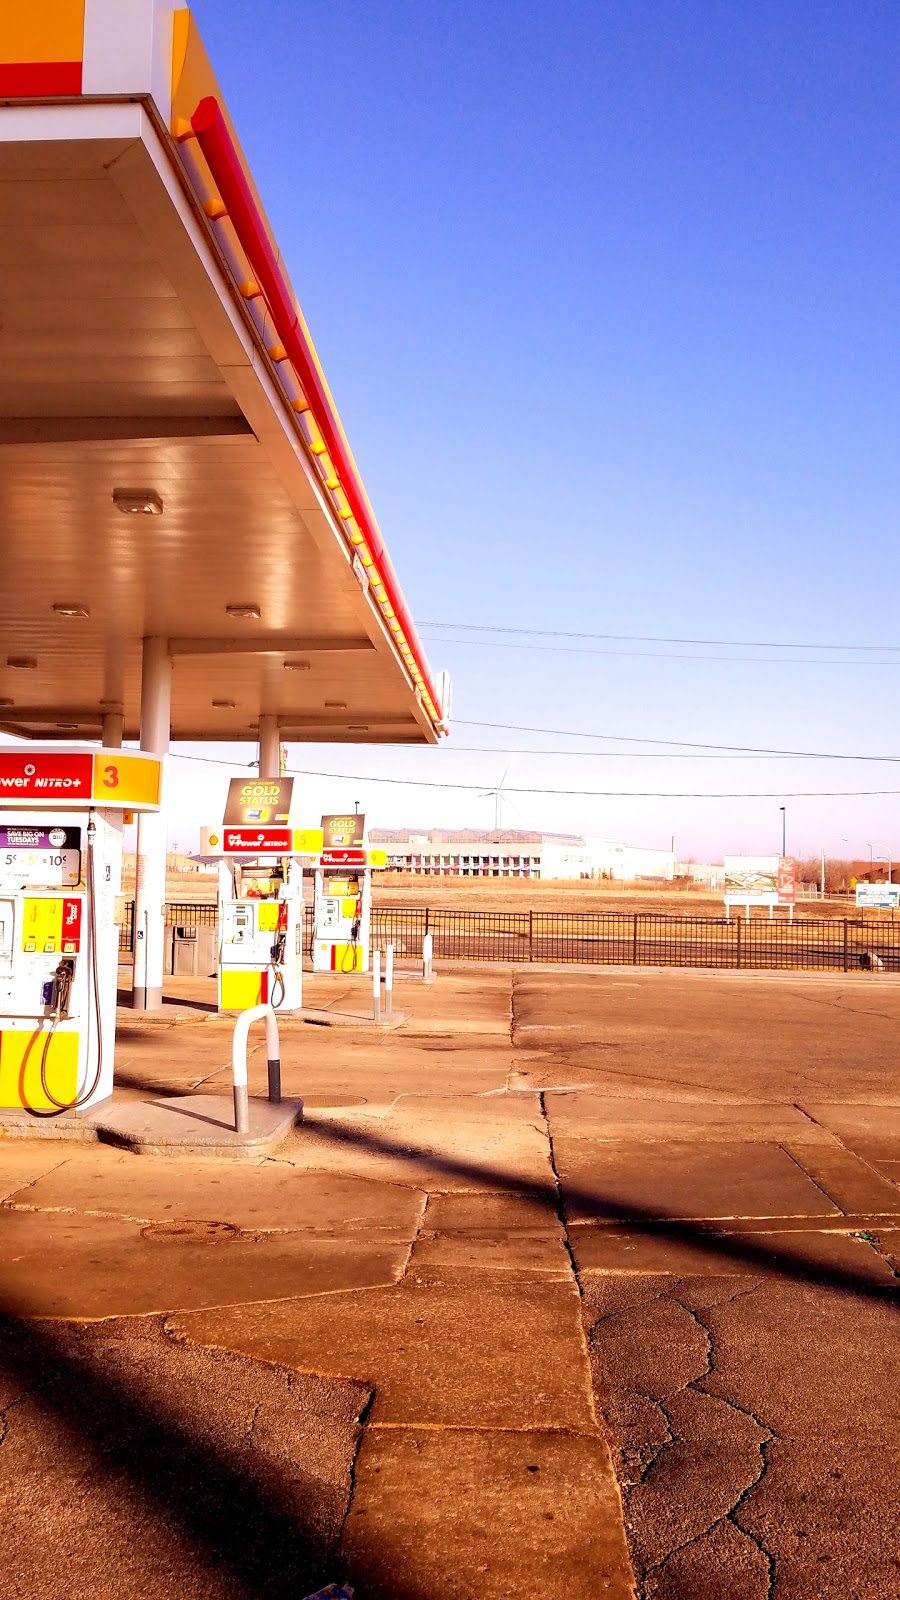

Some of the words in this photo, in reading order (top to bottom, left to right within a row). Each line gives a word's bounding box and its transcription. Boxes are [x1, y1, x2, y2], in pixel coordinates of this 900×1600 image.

[103, 765, 119, 788] 3
[241, 785, 281, 796] GOLD
[239, 796, 279, 805] STATUS
[329, 820, 356, 828] GOLD
[228, 839, 263, 847] V-Power
[299, 834, 307, 846] 5
[371, 854, 377, 862] 9
